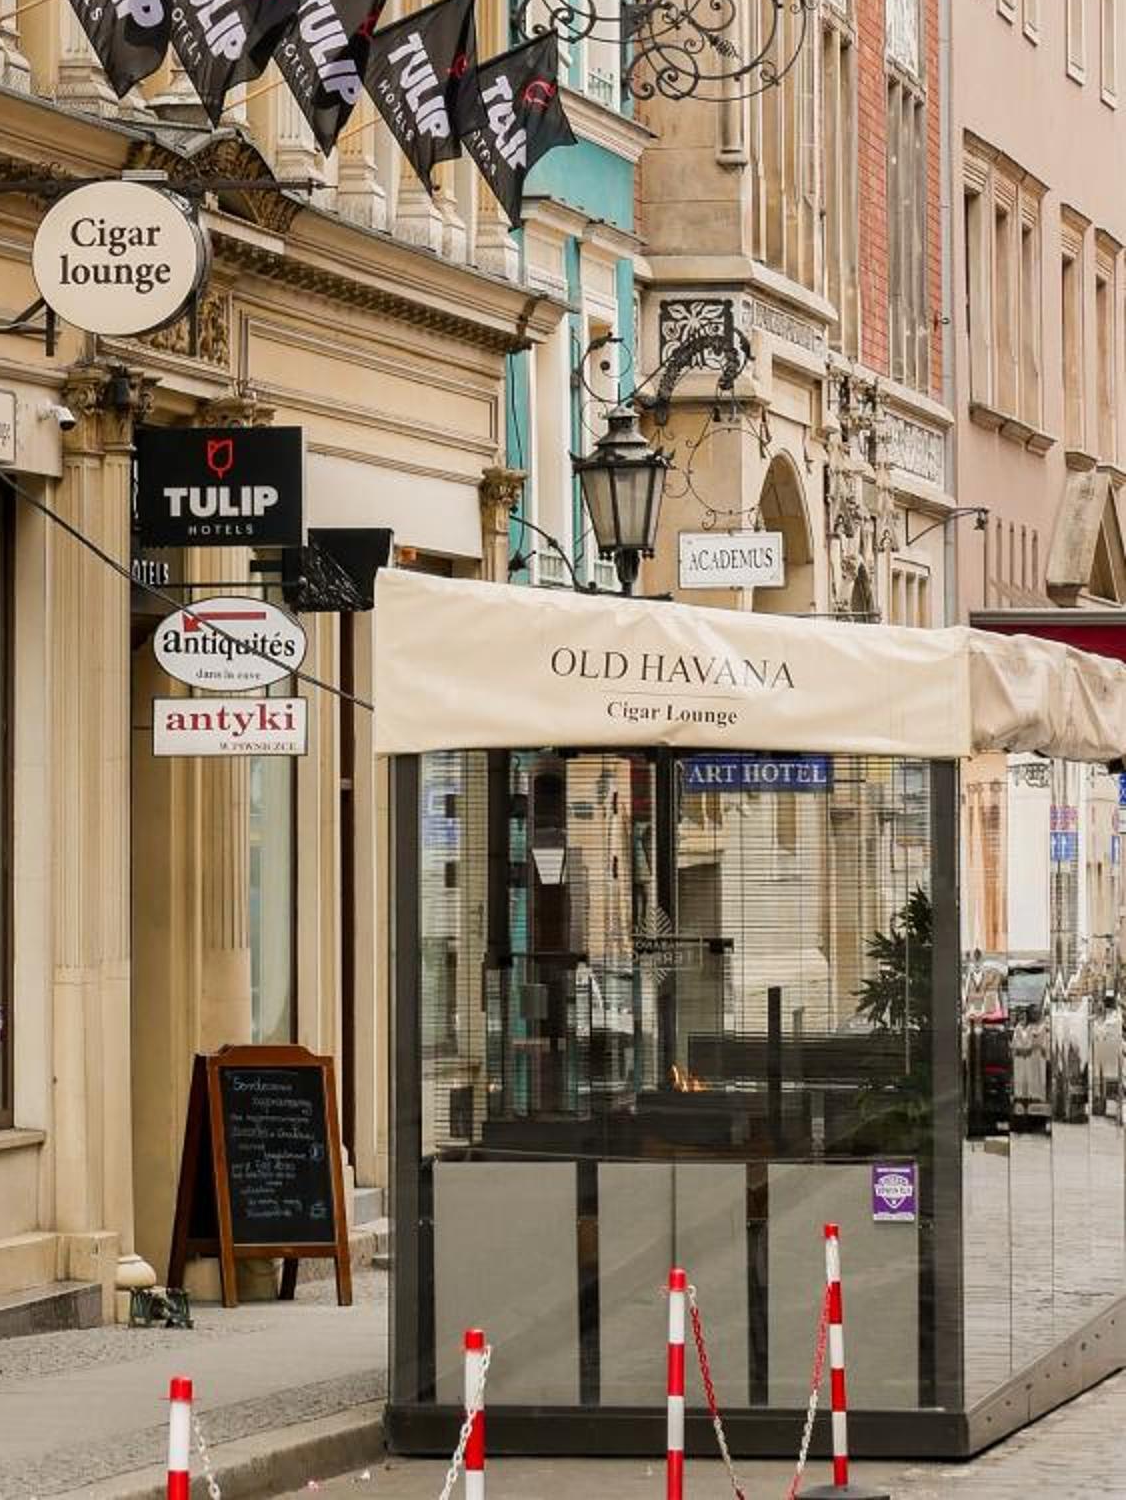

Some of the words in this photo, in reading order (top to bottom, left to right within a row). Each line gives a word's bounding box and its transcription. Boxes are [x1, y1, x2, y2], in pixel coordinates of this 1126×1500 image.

[171, 4, 202, 66] OTELS
[387, 32, 451, 138] TULIP
[377, 79, 415, 141] HOTELS
[71, 218, 161, 256] Cigar
[59, 254, 171, 294] lounge
[163, 485, 279, 517] TULIP
[188, 523, 254, 536] HOTELS
[688, 547, 773, 571] ACADEMUS
[163, 630, 296, 661] antiquités
[551, 647, 629, 680] OLD
[640, 652, 795, 689] HAVANA
[166, 703, 296, 737] antyki
[606, 701, 660, 723] Cigar
[666, 704, 738, 729] Lounge
[689, 763, 737, 783] ART
[742, 763, 827, 783] HOTEL
